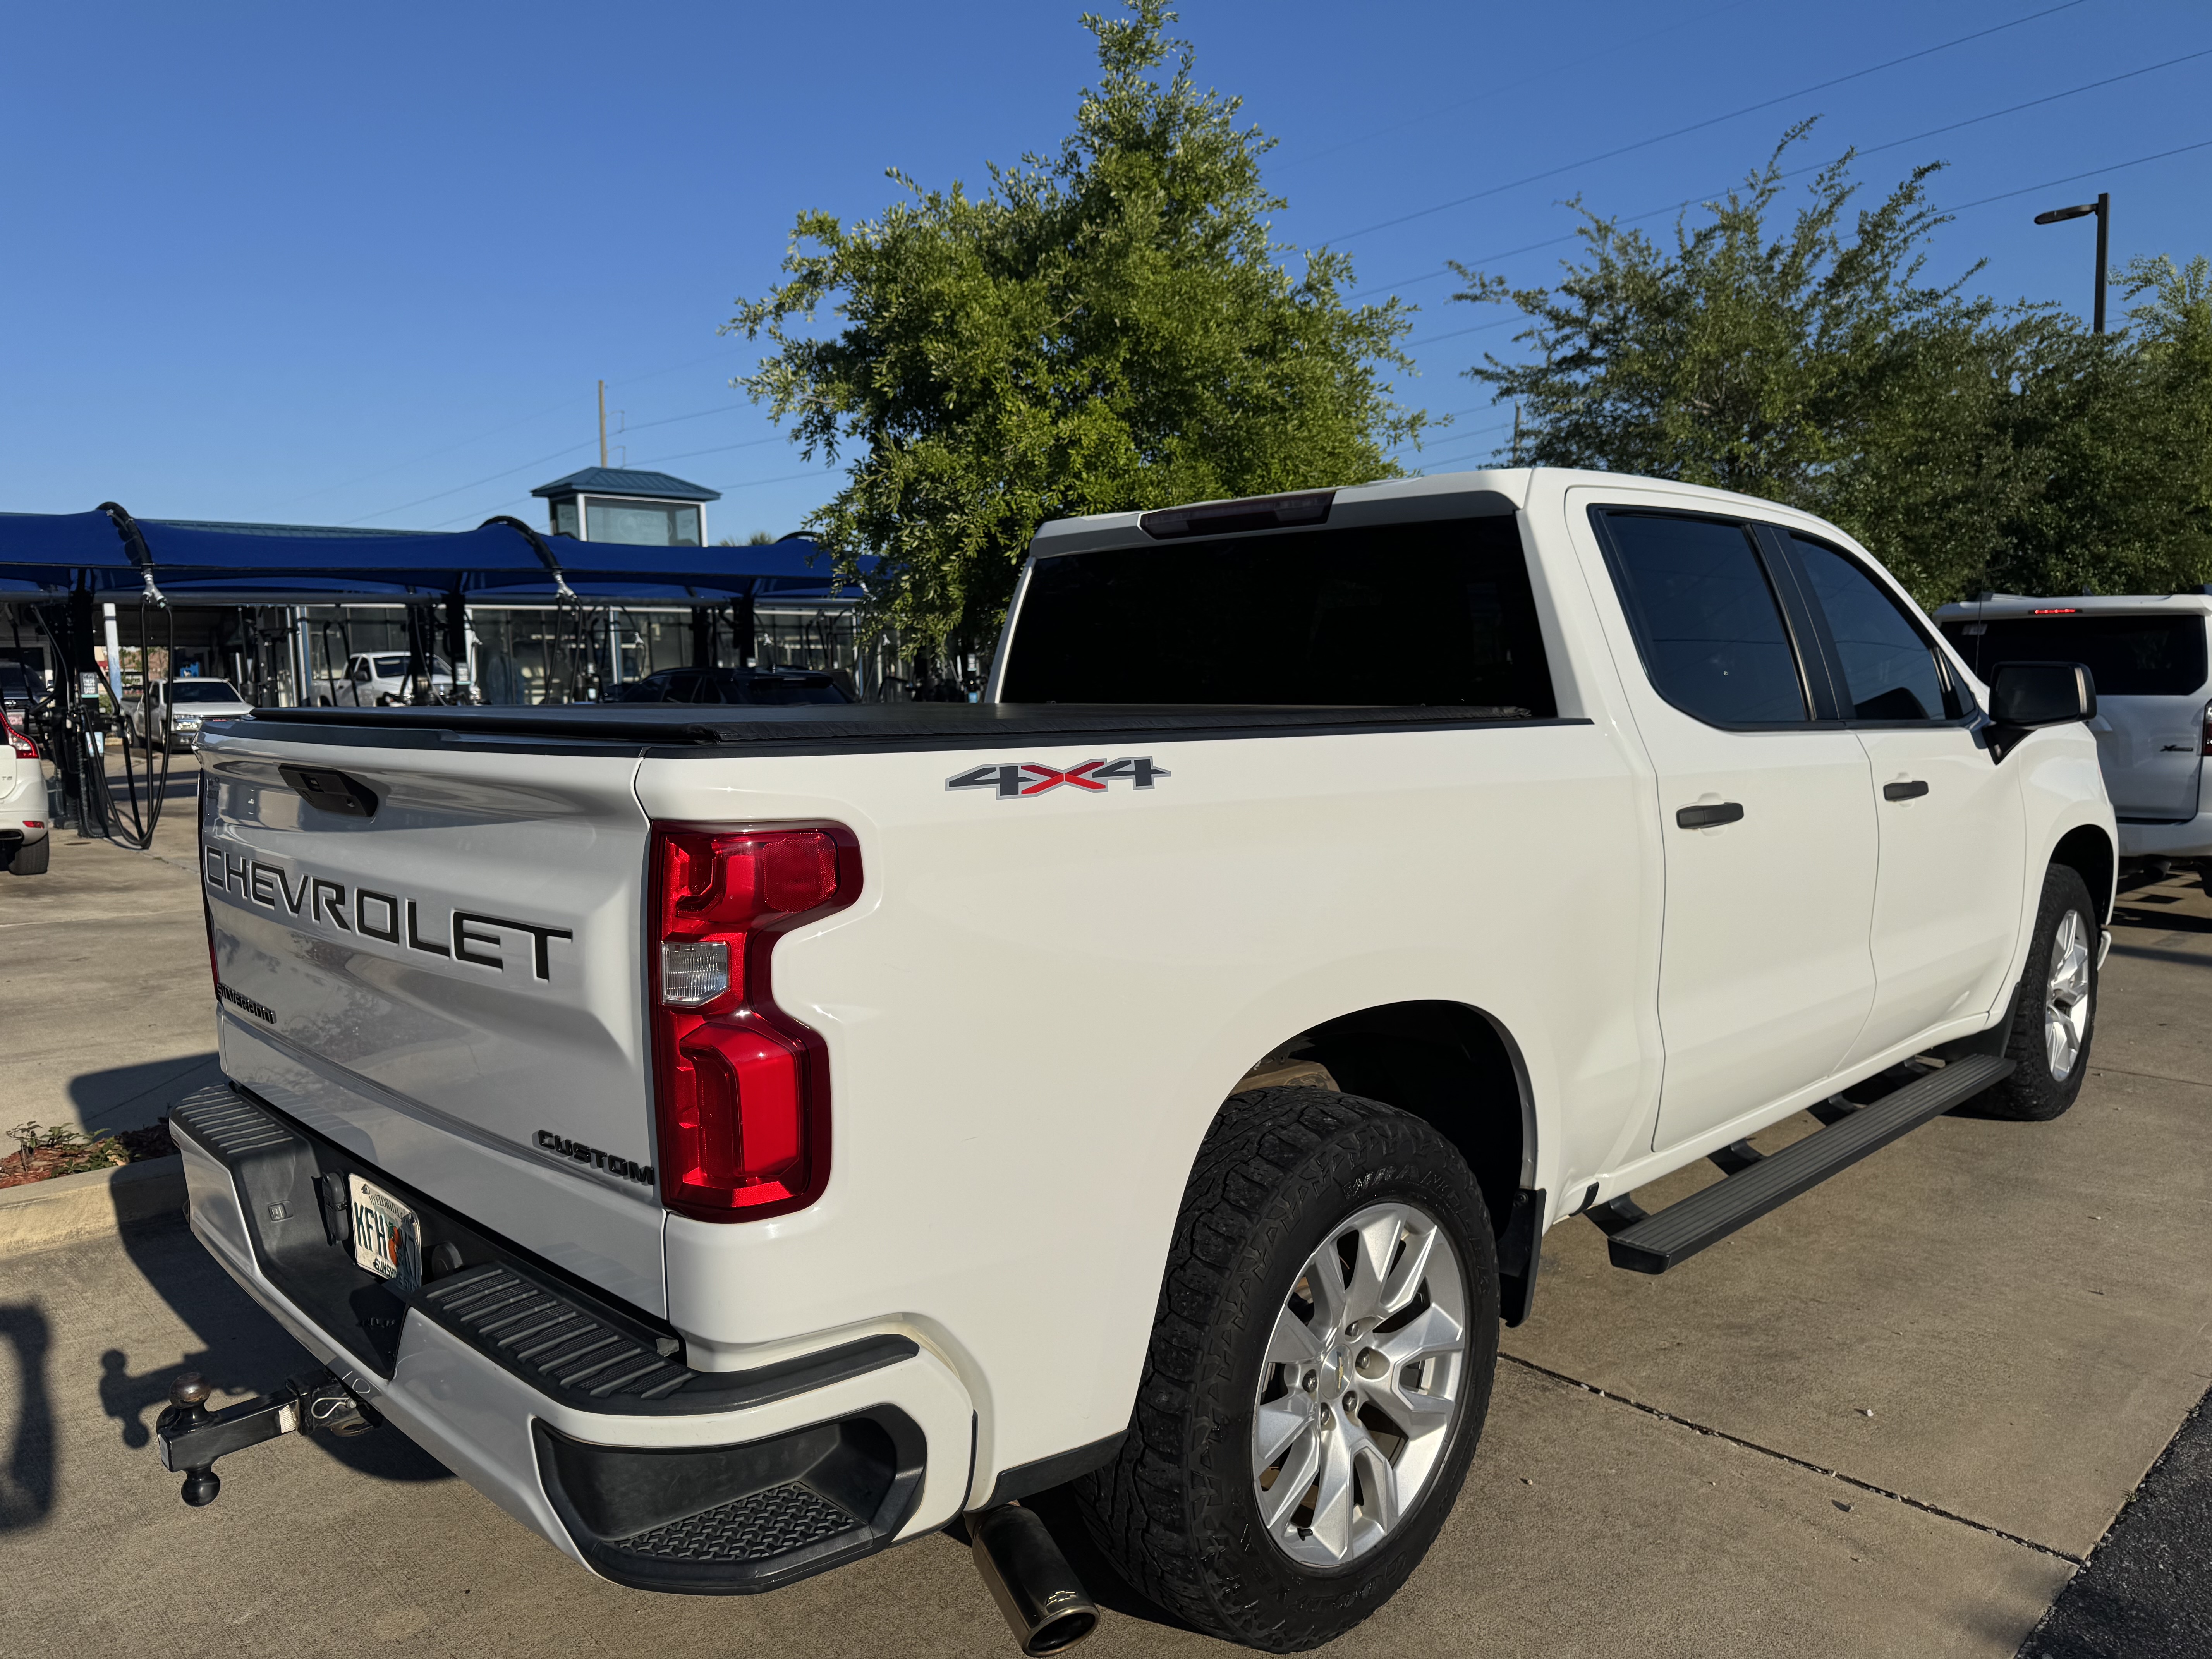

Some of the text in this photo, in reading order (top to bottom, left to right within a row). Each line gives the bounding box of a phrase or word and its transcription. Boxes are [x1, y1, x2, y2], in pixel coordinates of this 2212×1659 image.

[205, 845, 574, 982] CHEVROLET
[217, 982, 277, 1024] SILVERADO
[538, 1129, 655, 1185] CUSTOM
